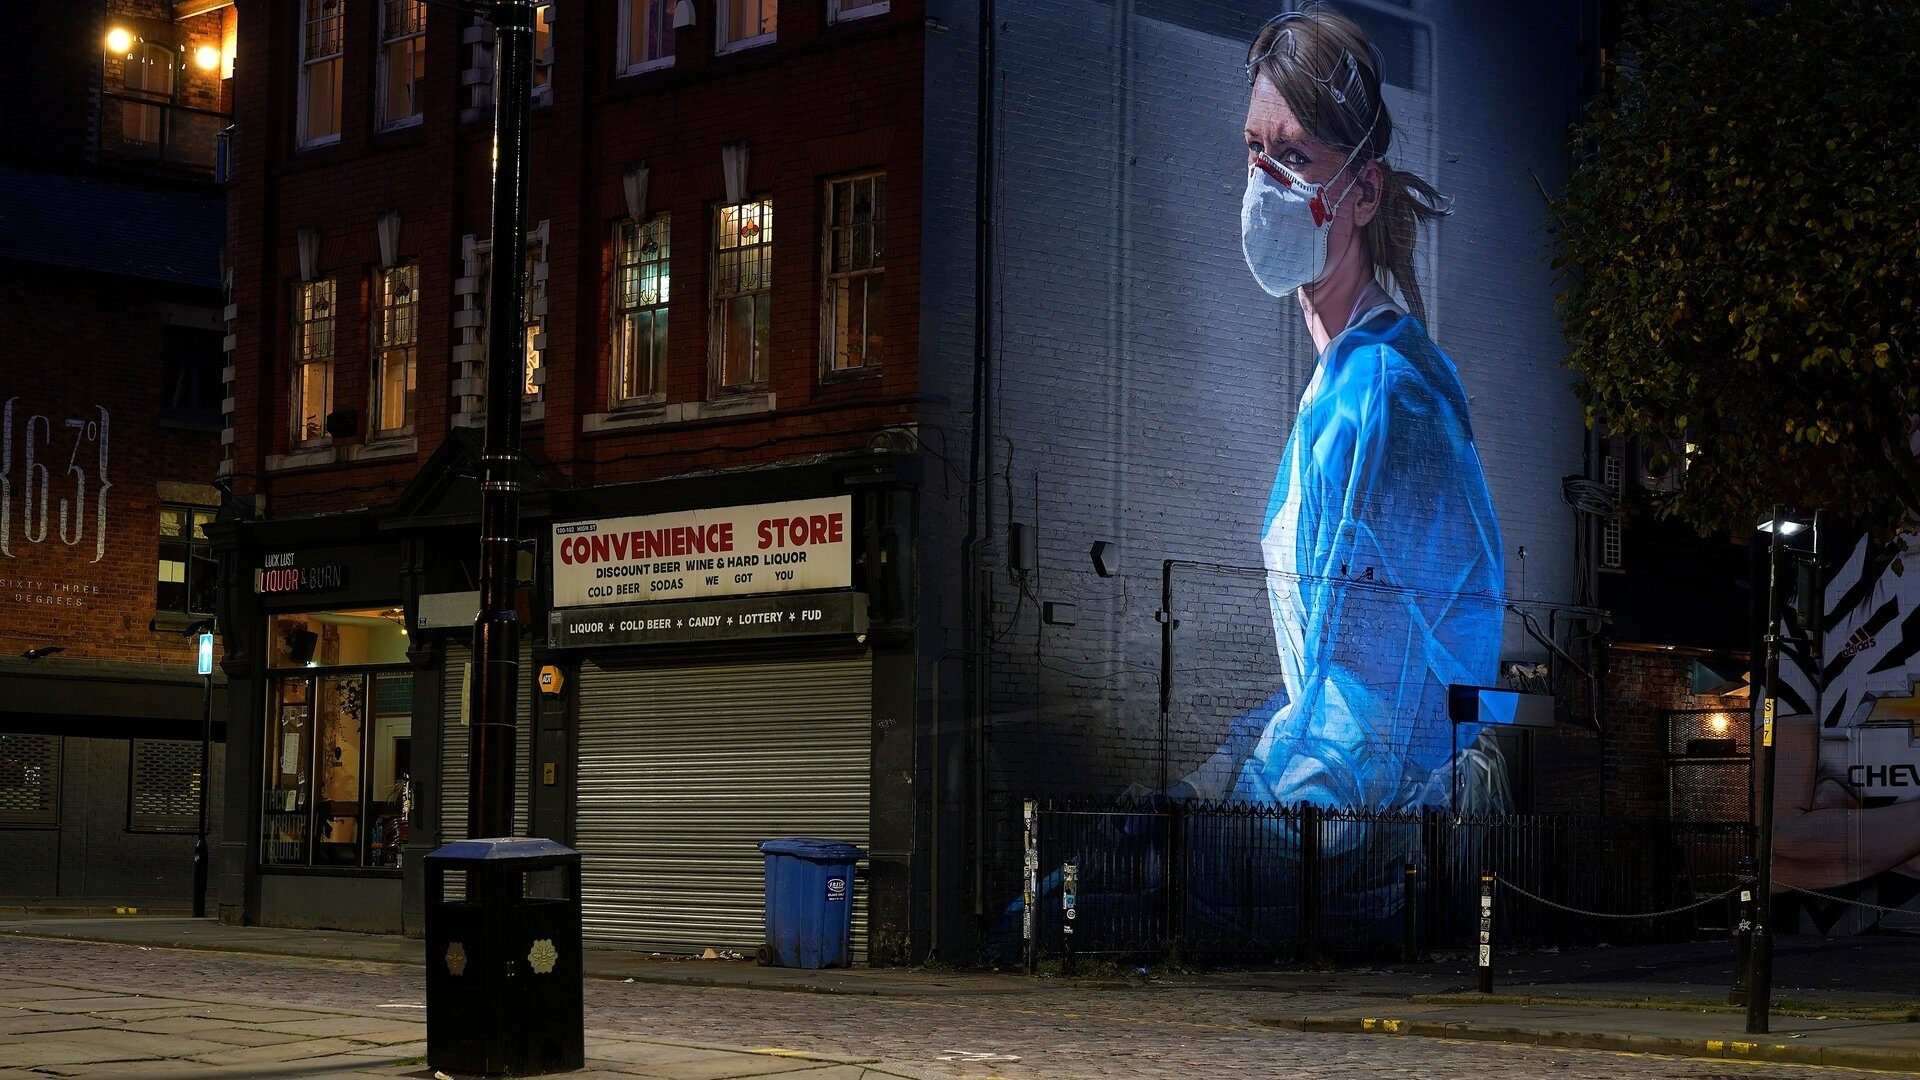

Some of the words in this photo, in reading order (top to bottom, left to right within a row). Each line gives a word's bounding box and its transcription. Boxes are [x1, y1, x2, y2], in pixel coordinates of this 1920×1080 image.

[560, 522, 734, 565] CONVENIENCE
[757, 513, 843, 549] STORE
[264, 554, 279, 568] LUCK
[280, 552, 295, 567] LUST
[596, 564, 650, 579] DISCOUNT
[653, 561, 681, 574] BEER
[686, 558, 714, 571] WINE
[716, 557, 725, 569] &
[727, 554, 759, 568] HARD
[764, 551, 807, 566] LIQUOR
[0, 578, 42, 590] SIXTY
[52, 582, 99, 595] THREE
[260, 568, 299, 593] LIQUOR
[301, 568, 306, 585] &
[309, 564, 341, 589] BURN
[588, 585, 613, 598] COLD
[616, 582, 640, 595] BEER
[650, 578, 684, 592] SODAS
[705, 575, 719, 586] WE
[734, 573, 753, 583] GOT
[775, 570, 794, 580] YOU
[15, 593, 83, 607] DEGREES
[569, 622, 604, 634] LIQUOR
[620, 620, 644, 631] COLD
[646, 618, 671, 630] BEER
[688, 615, 722, 628] CANDY
[739, 611, 784, 625] LOTTERY
[801, 609, 822, 621] FUD
[1843, 637, 1876, 657] adidas
